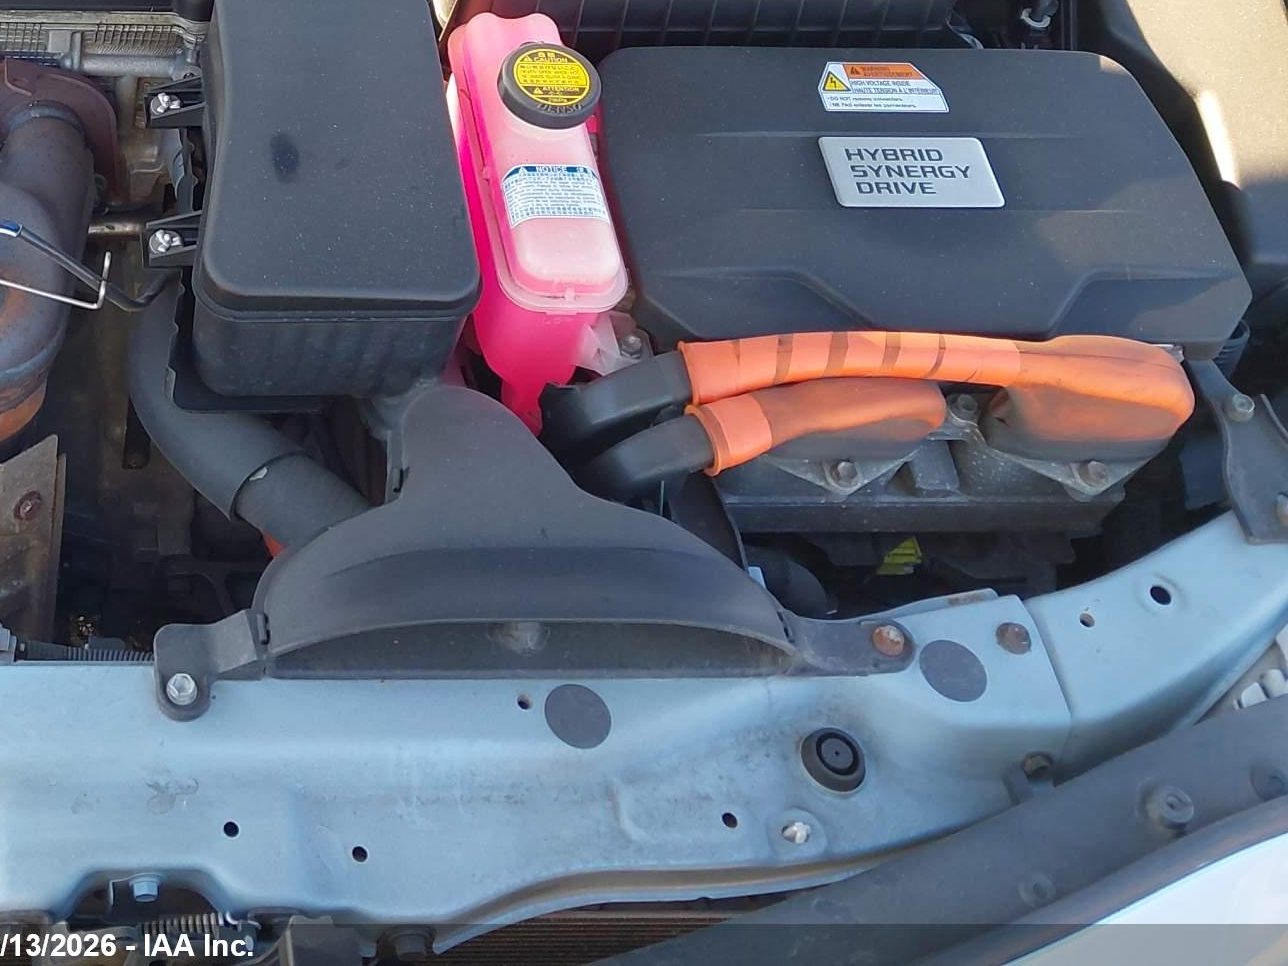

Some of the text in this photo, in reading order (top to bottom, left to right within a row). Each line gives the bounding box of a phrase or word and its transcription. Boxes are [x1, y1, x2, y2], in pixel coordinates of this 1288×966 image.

[844, 148, 943, 162] HYBRID
[850, 165, 971, 179] SYNERGY
[856, 181, 937, 195] DRIVE
